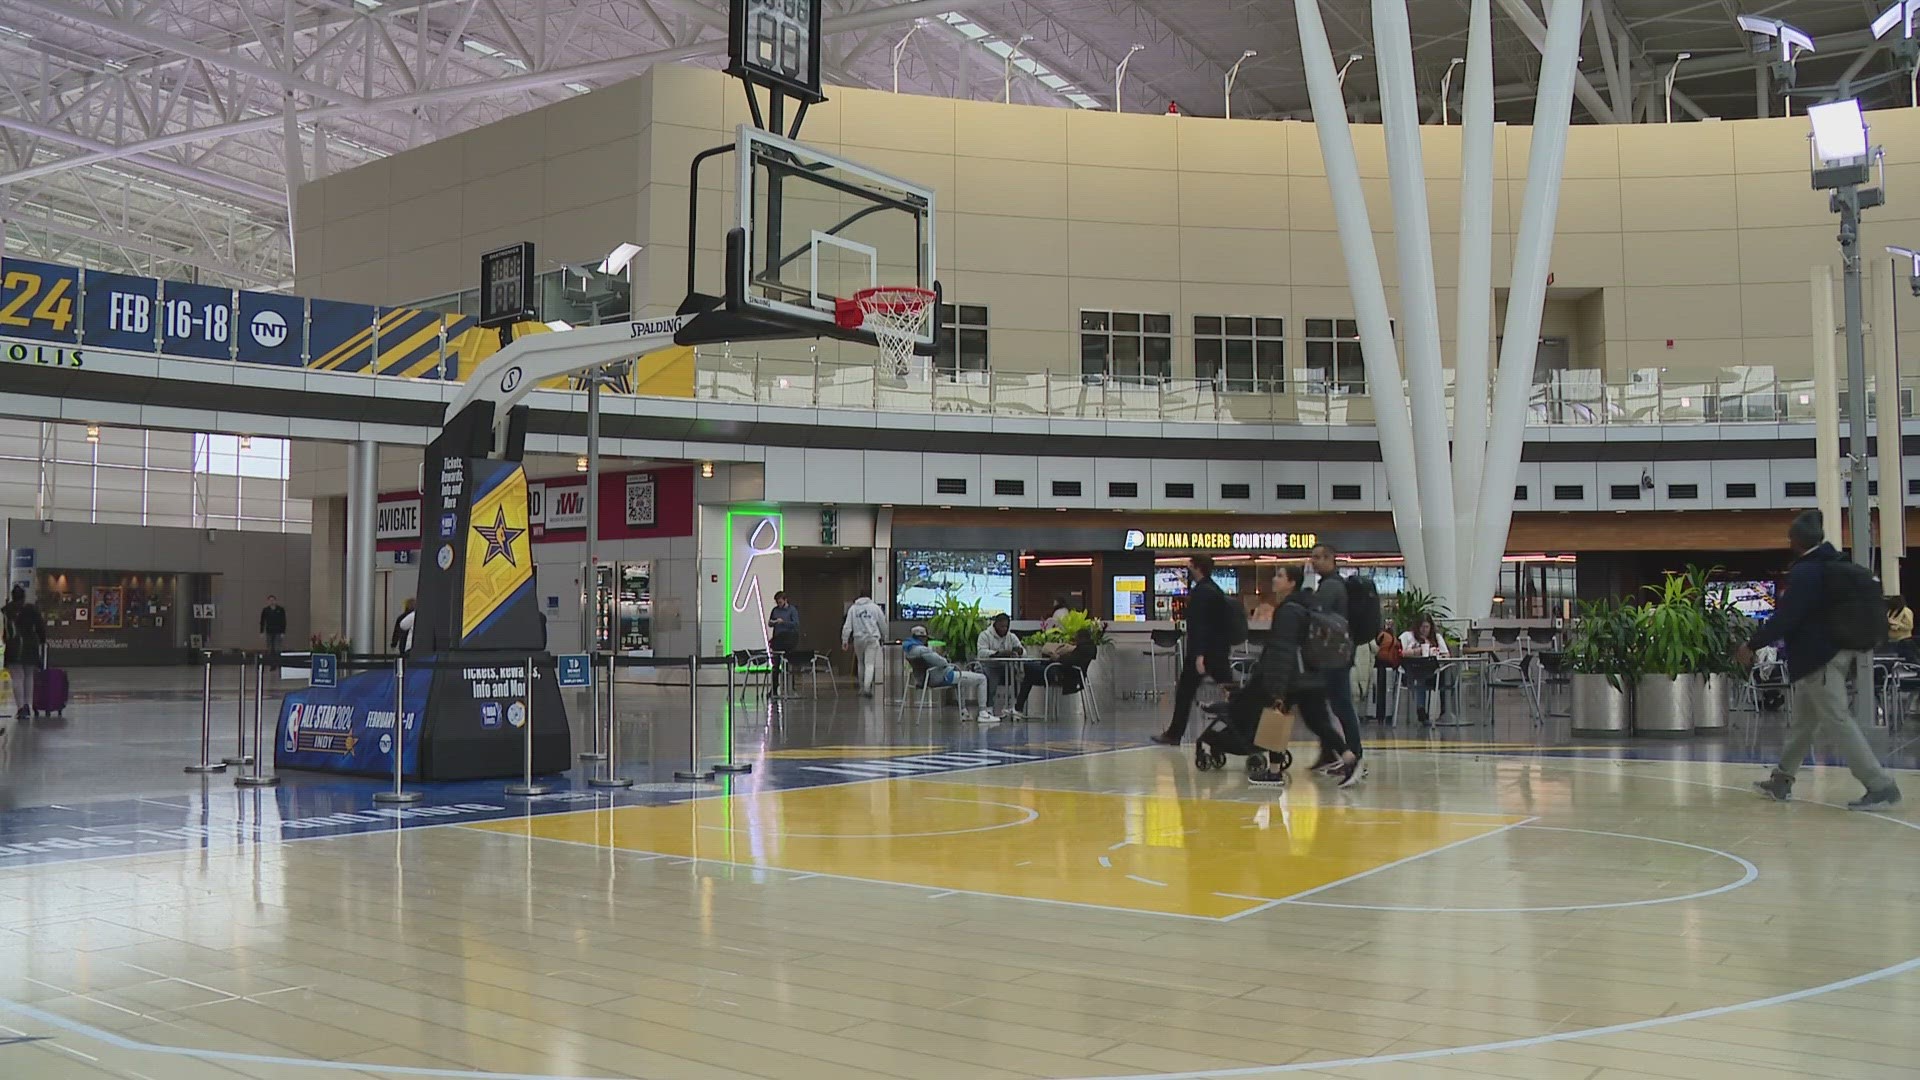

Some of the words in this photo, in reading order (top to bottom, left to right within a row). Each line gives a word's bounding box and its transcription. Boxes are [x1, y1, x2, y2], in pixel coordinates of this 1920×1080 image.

[110, 291, 150, 333] FEB
[166, 299, 229, 343] 16-18
[630, 316, 682, 339] SPALDING
[1146, 532, 1189, 548] INDIANA
[1191, 533, 1231, 549] PACERS
[1232, 533, 1288, 549] COURTSIDE
[1289, 533, 1316, 549] CLUB
[500, 662, 541, 680] Rewas,
[473, 680, 491, 698] Info
[492, 680, 509, 697] and
[334, 705, 354, 730] 2024
[365, 710, 396, 728] FEBRUARY
[313, 735, 334, 749] INDY
